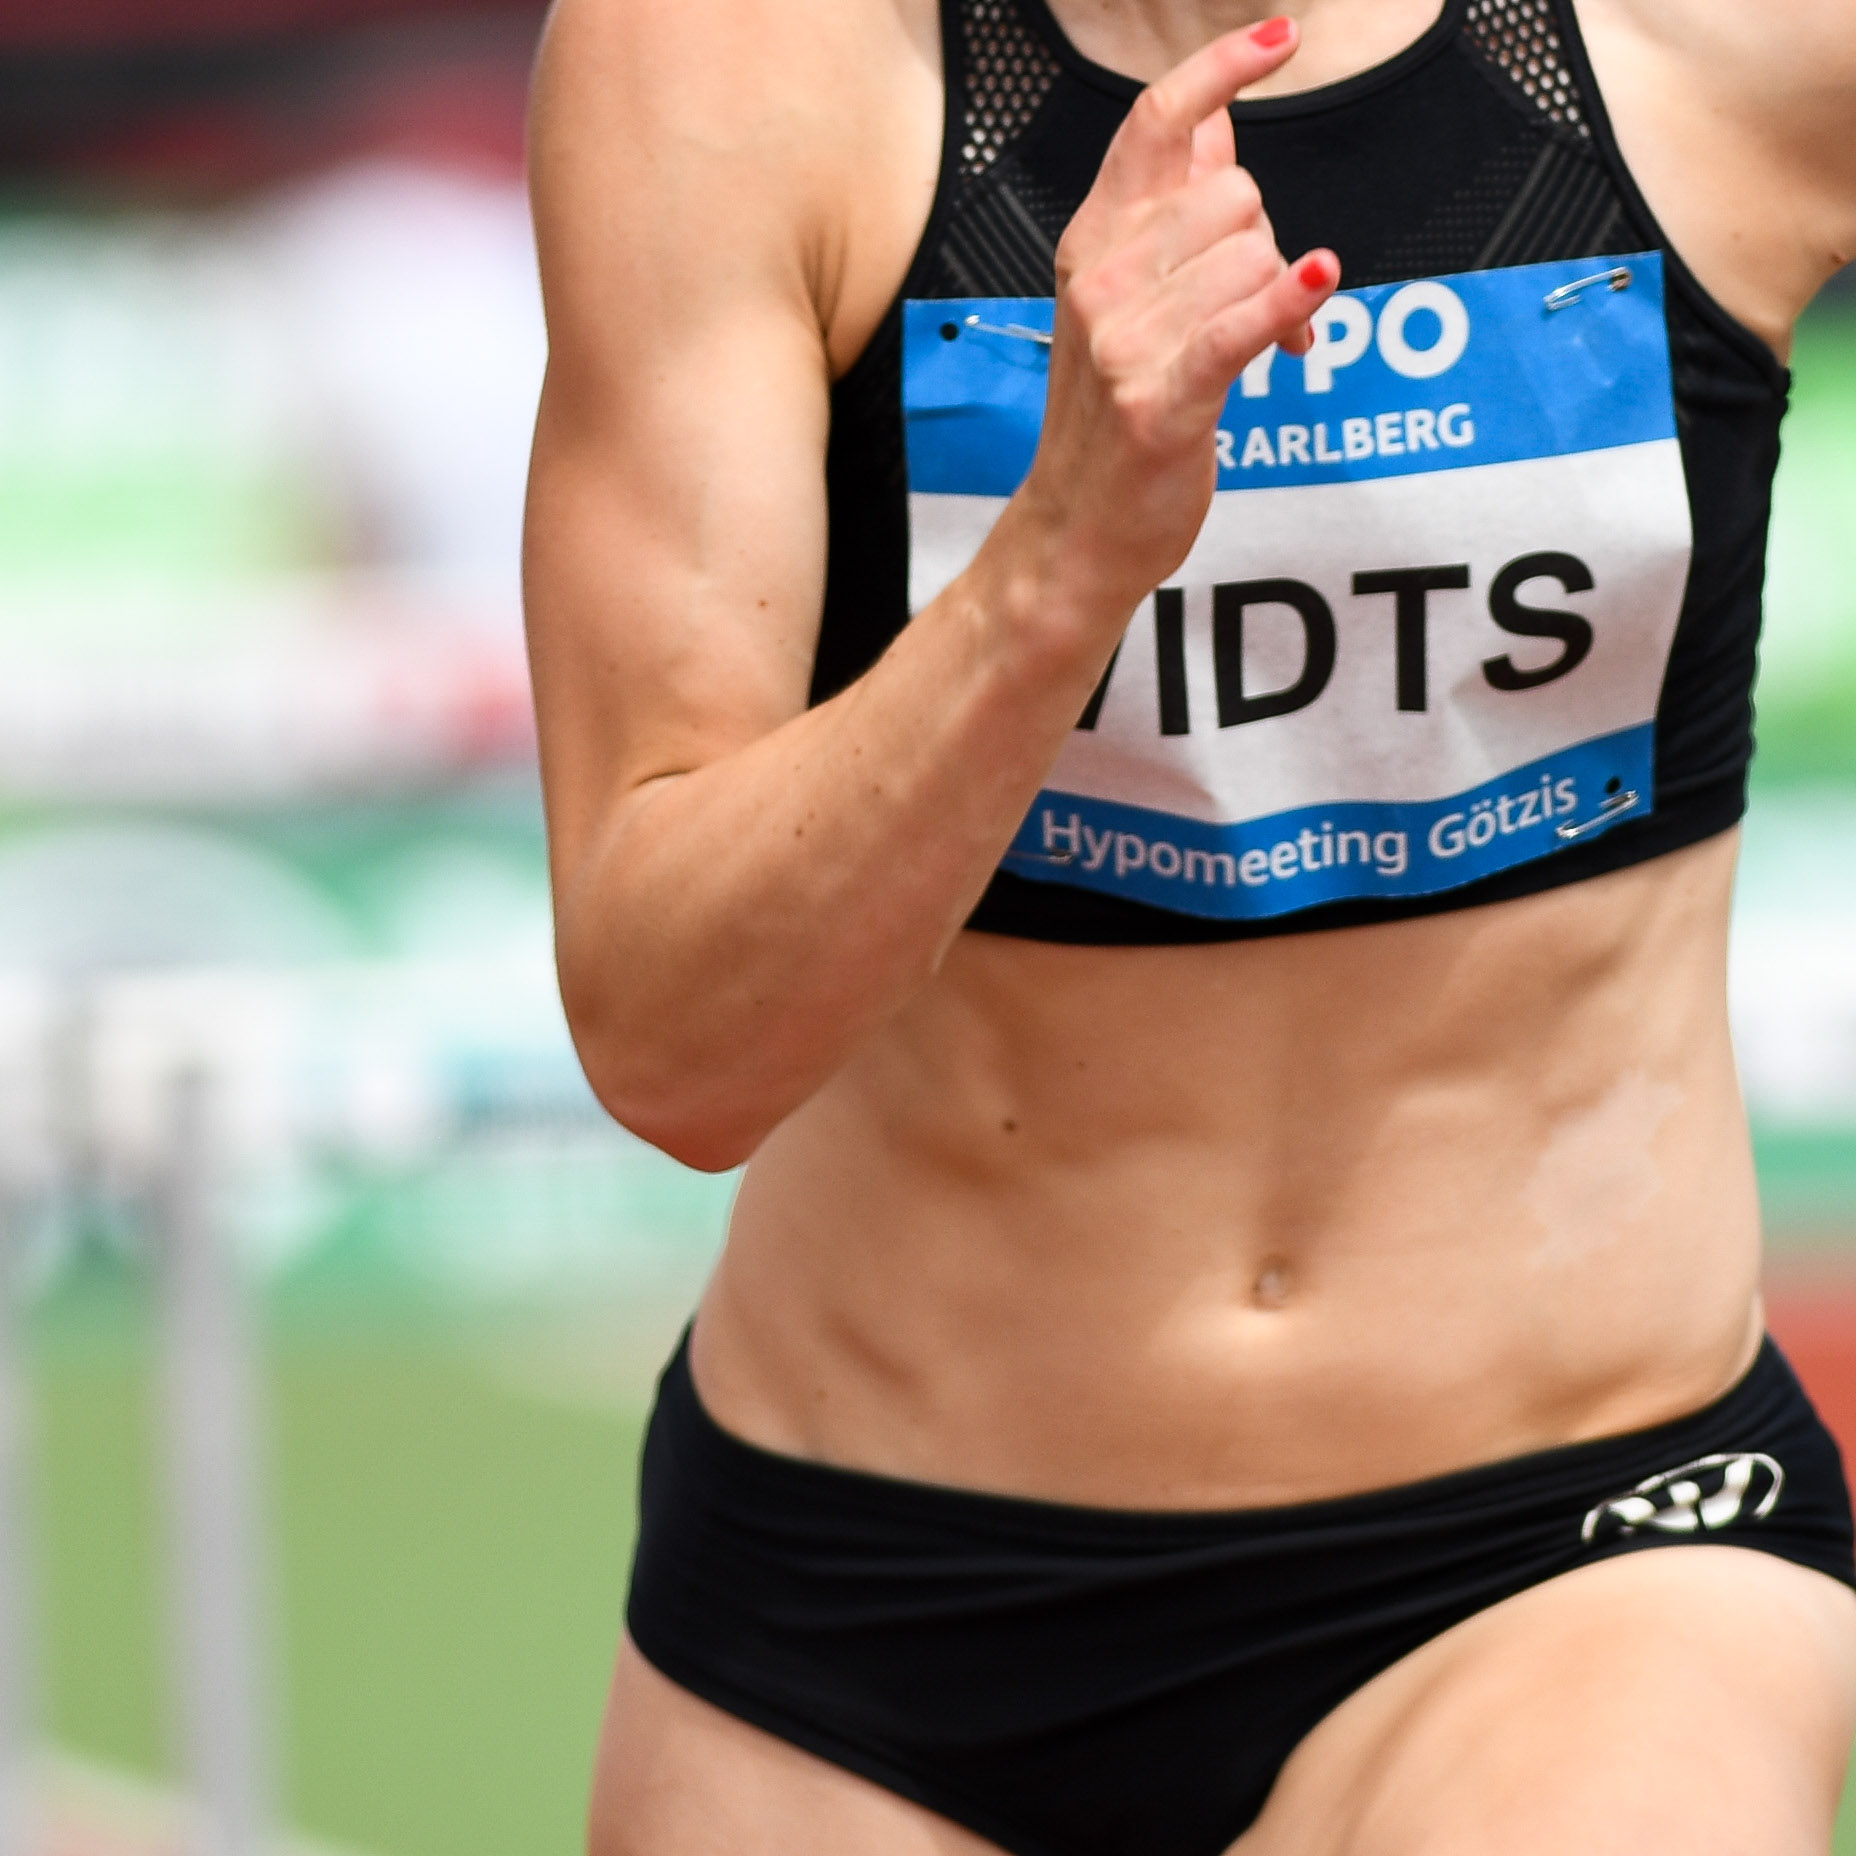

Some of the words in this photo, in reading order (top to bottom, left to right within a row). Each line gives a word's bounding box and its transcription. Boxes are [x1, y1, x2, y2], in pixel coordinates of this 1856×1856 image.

[1076, 550, 1595, 736] IDTS
[1043, 808, 1408, 887] Hypomeeting
[1428, 774, 1579, 859] Götzis
